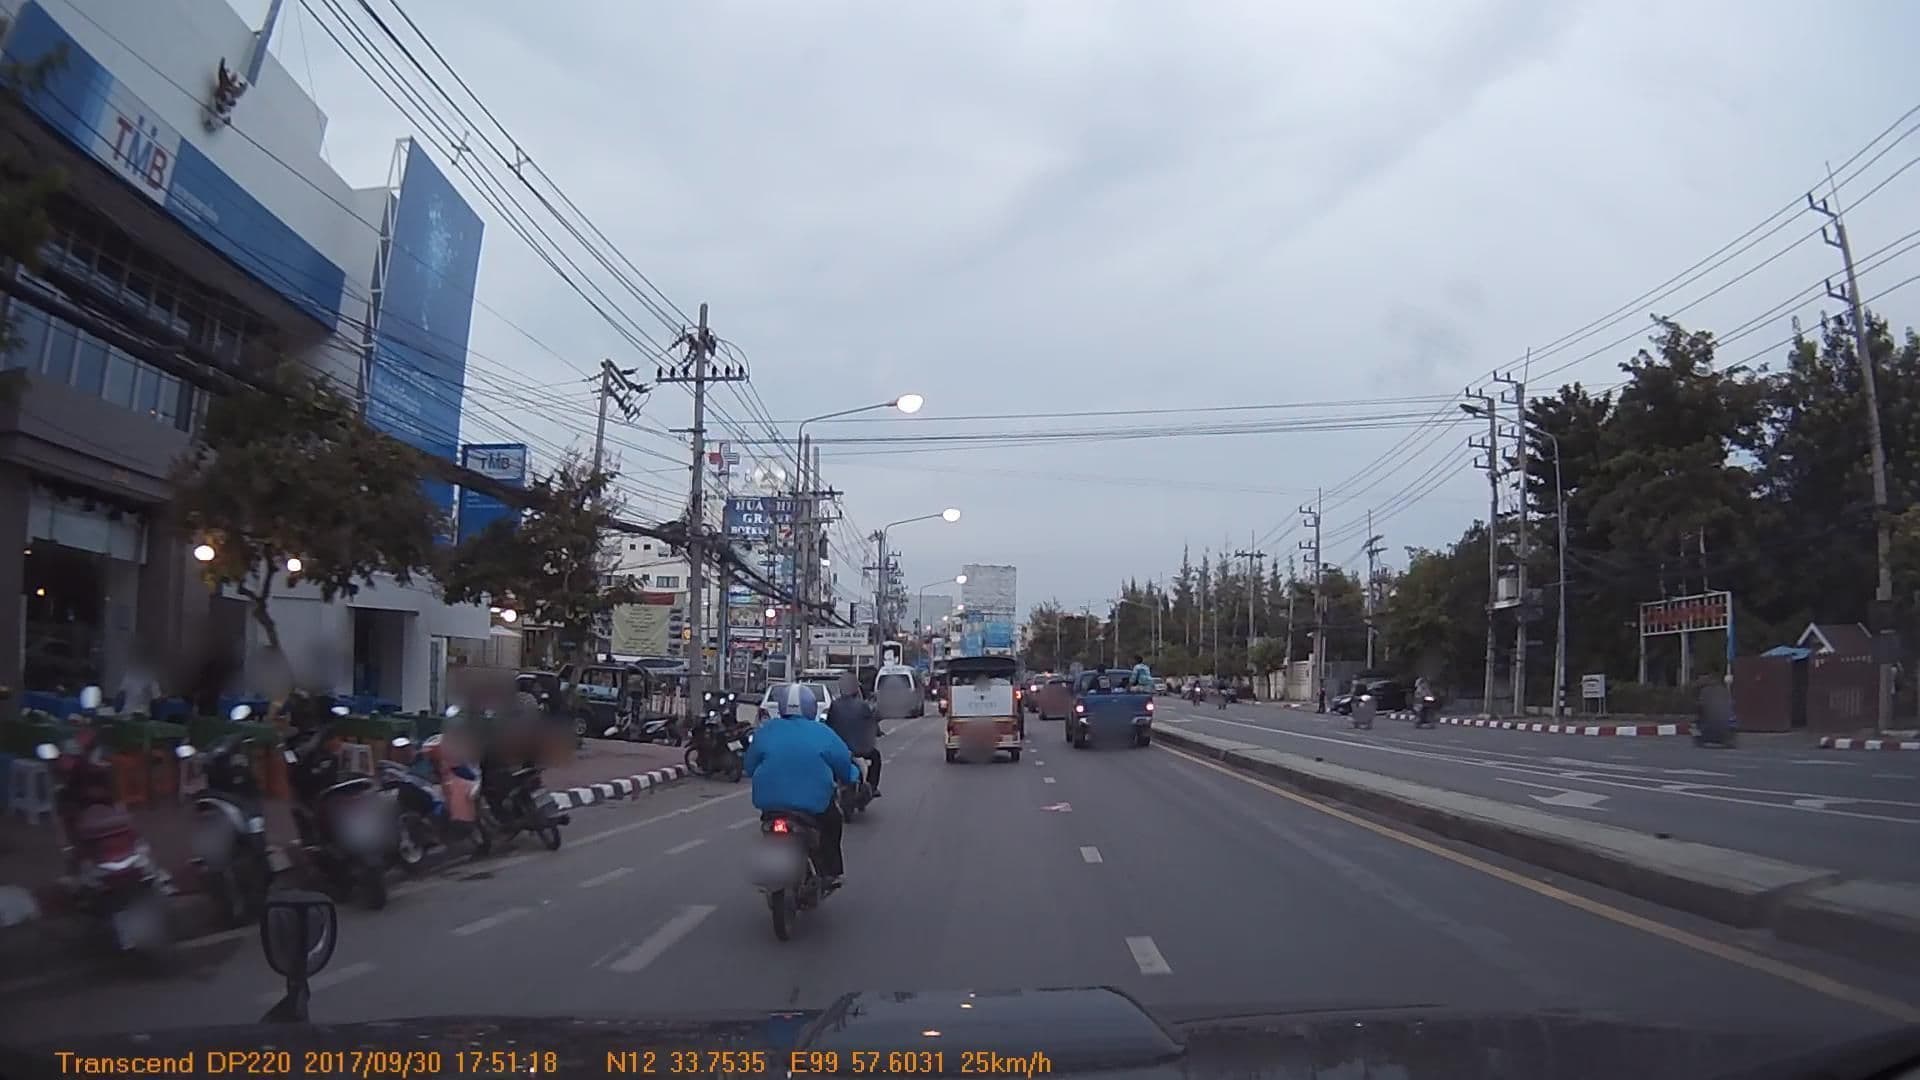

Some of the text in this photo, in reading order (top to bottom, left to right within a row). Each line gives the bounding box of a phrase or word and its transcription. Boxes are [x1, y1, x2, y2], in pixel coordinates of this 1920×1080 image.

[113, 116, 168, 190] TMB
[480, 454, 510, 470] TMB
[735, 500, 764, 511] HUA
